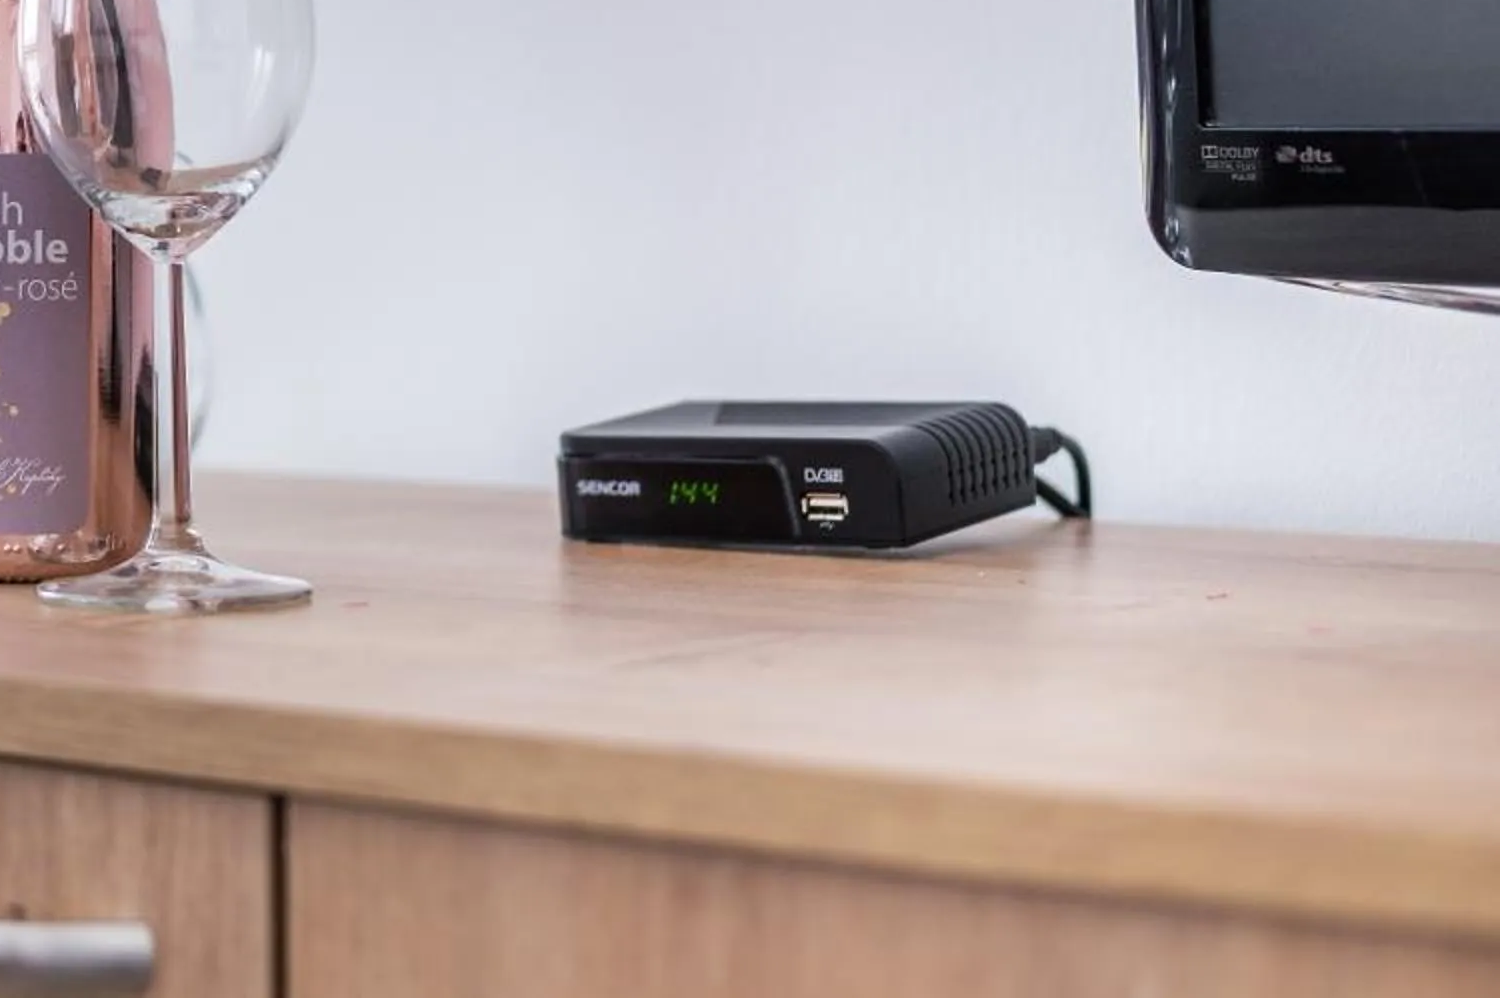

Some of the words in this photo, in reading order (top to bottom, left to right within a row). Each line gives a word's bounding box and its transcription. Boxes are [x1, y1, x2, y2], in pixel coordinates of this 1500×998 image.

[1300, 145, 1333, 164] dts
[576, 479, 641, 496] SENCOR
[670, 481, 719, 504] 144
